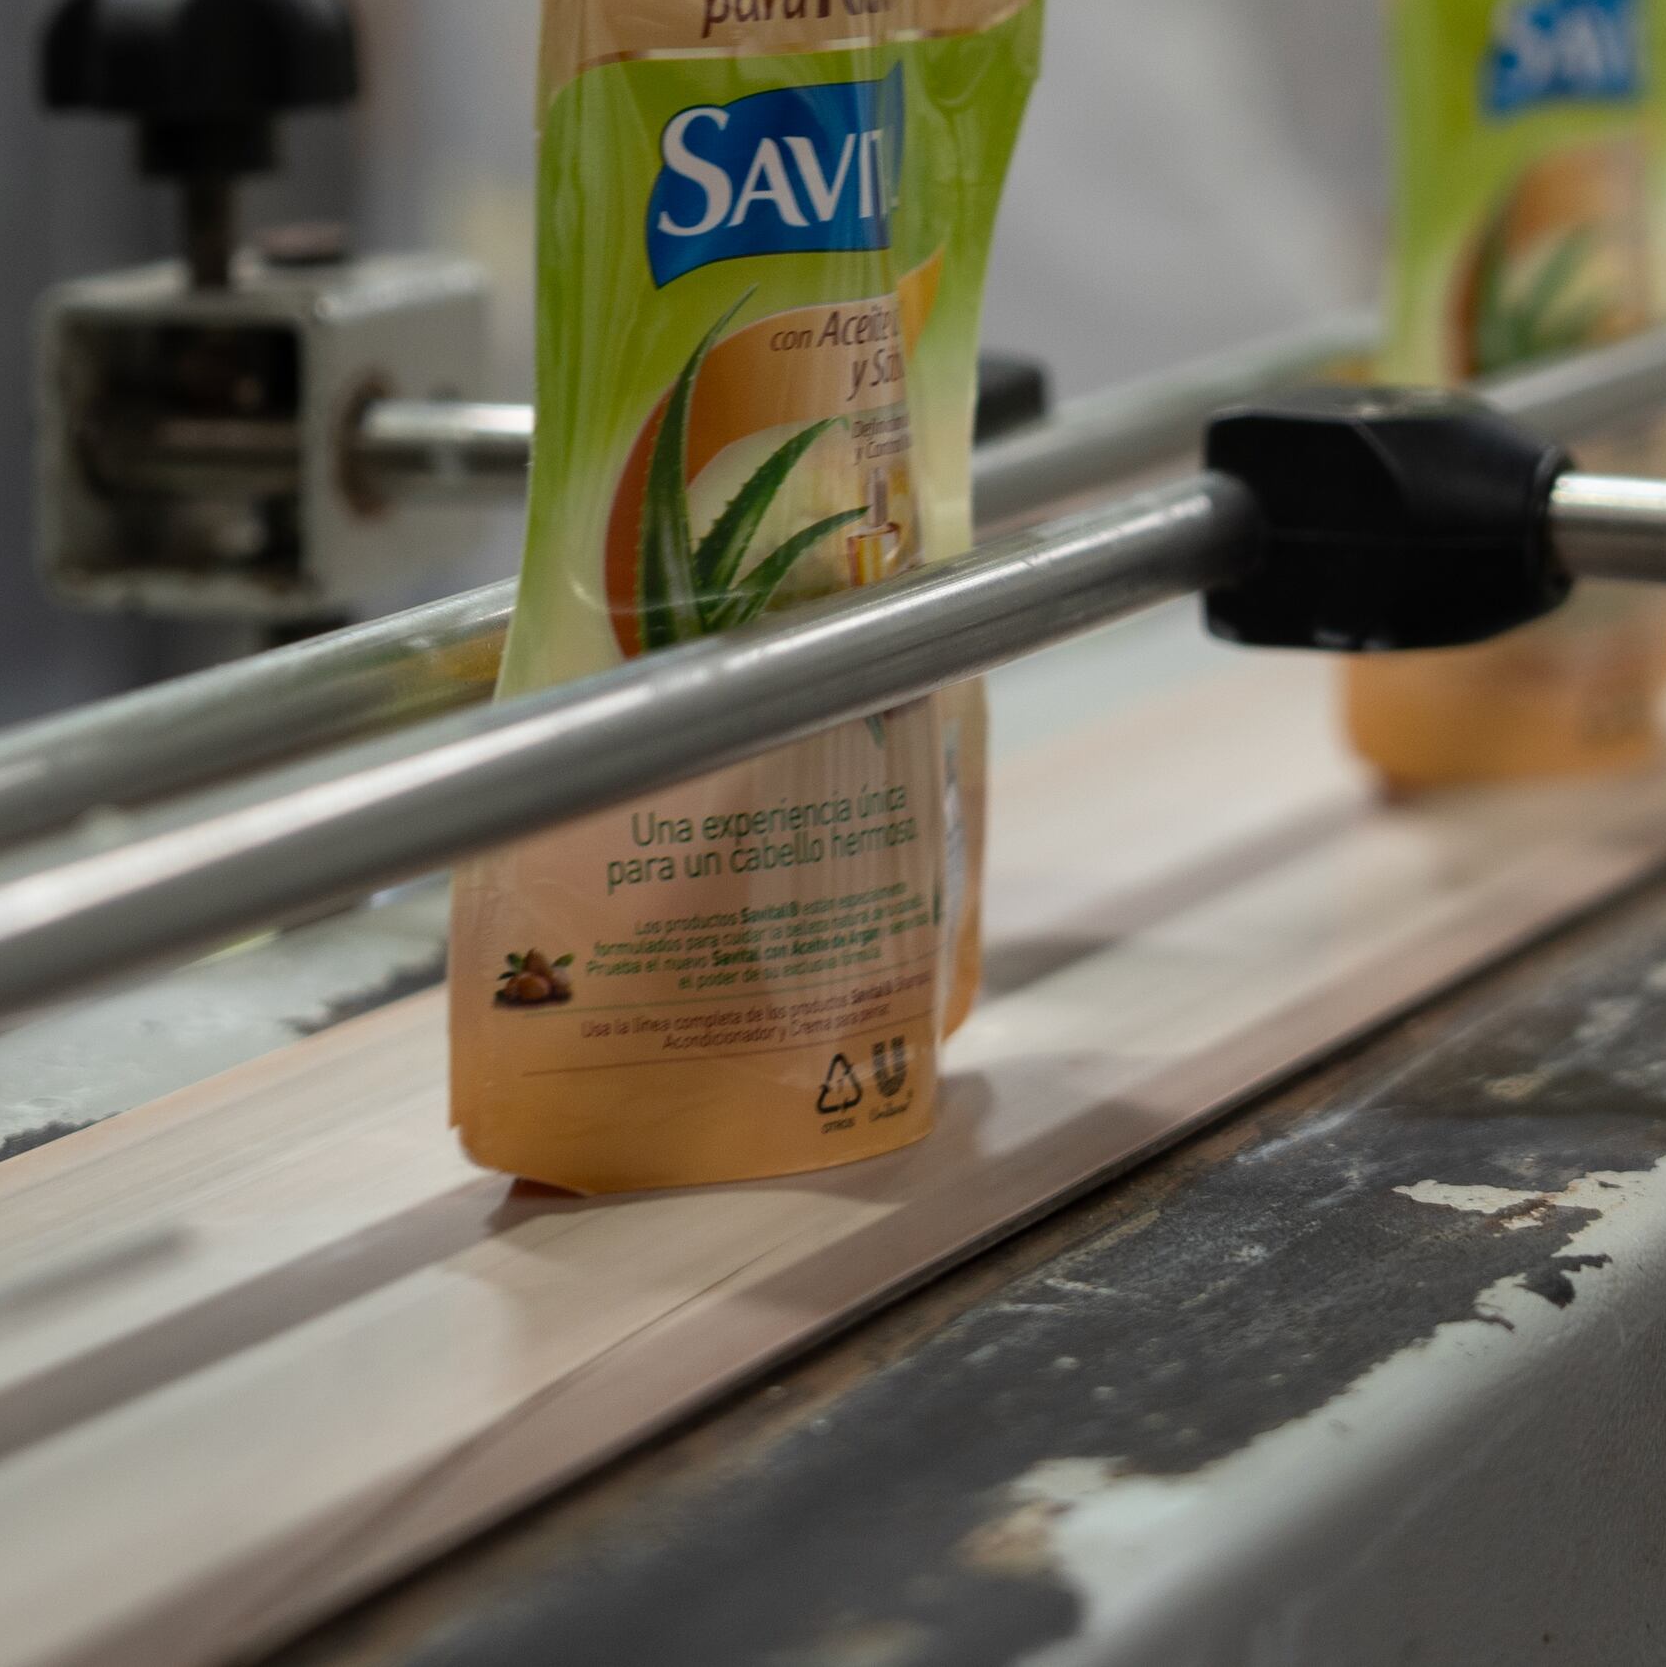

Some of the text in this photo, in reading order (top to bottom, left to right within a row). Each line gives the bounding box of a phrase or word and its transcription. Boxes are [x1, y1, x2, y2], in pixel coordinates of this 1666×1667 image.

[770, 329, 813, 352] con
[846, 359, 869, 402] y
[631, 810, 694, 847] Una
[701, 790, 851, 846] experiencia
[607, 855, 675, 896] para
[684, 850, 723, 880] un
[729, 832, 824, 874] cabello
